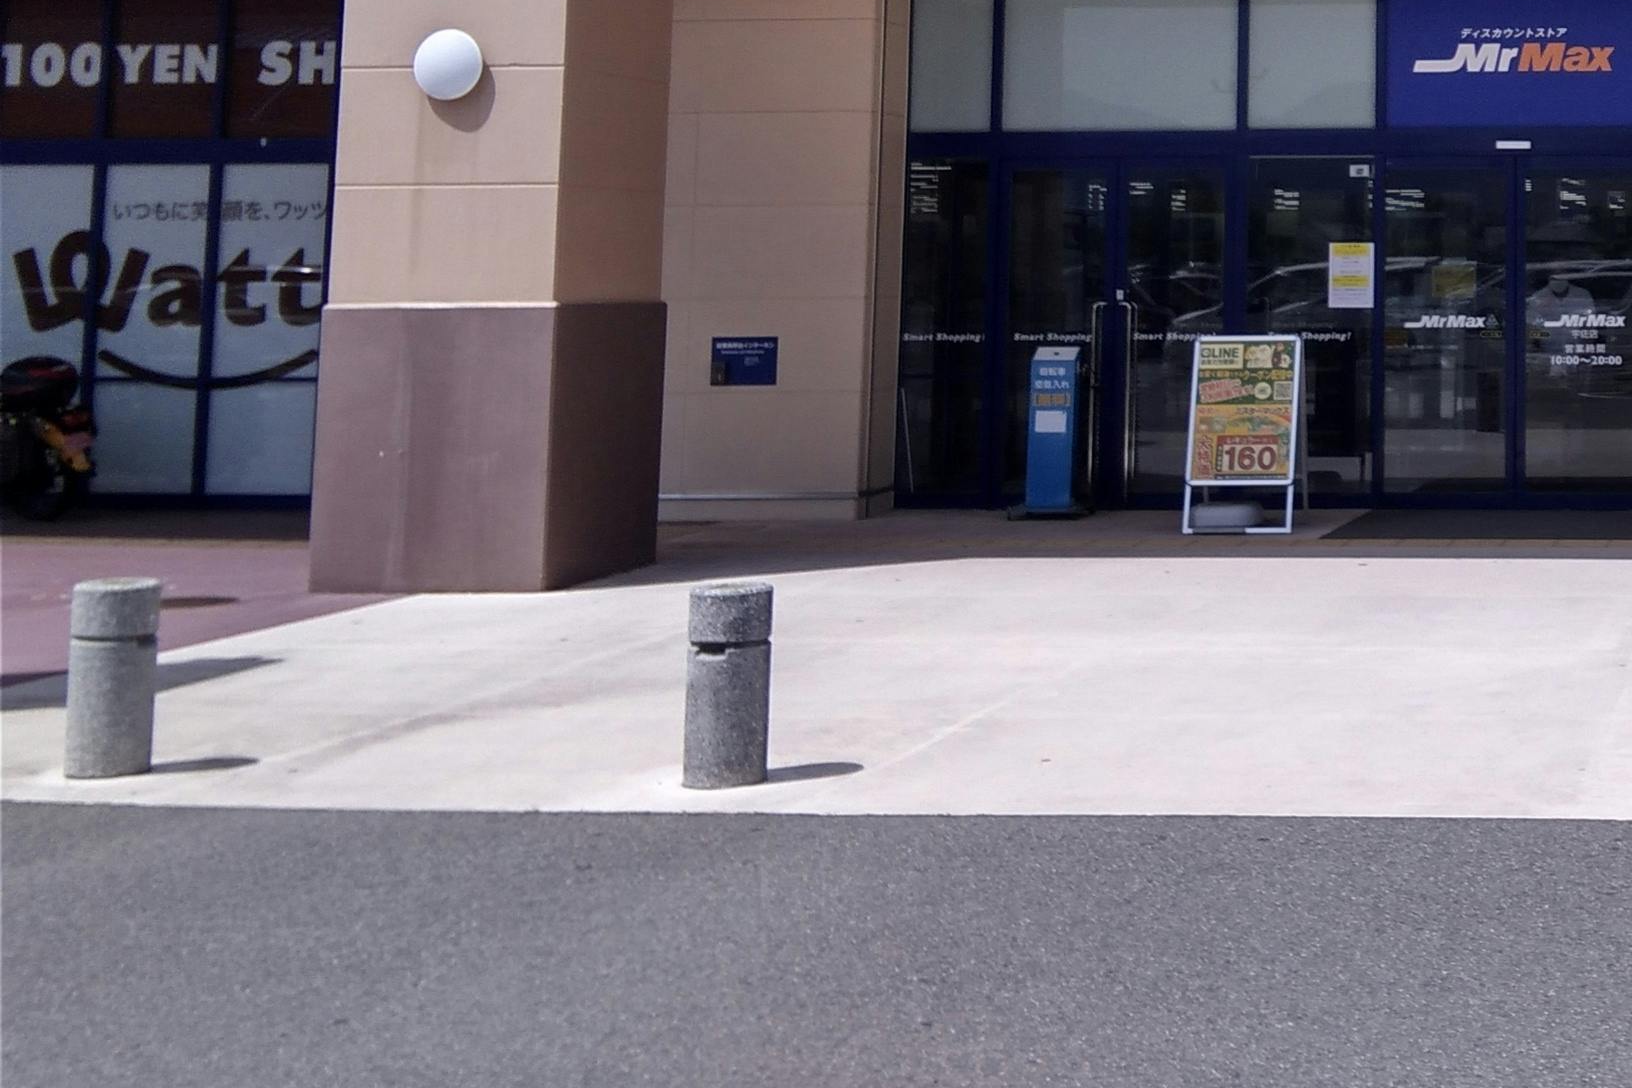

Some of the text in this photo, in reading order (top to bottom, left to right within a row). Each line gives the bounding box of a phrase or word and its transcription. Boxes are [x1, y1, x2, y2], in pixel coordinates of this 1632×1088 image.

[1461, 27, 1567, 39] ディスカウントストア
[1, 40, 336, 87] 100 YEN SH
[1413, 43, 1615, 73] MrMax
[1404, 315, 1486, 328] MrMax
[1544, 314, 1626, 327] MrMax
[903, 332, 933, 341] Smart
[1014, 332, 1044, 341] Smart
[1133, 332, 1163, 340] Smart
[1224, 446, 1277, 471] 160
